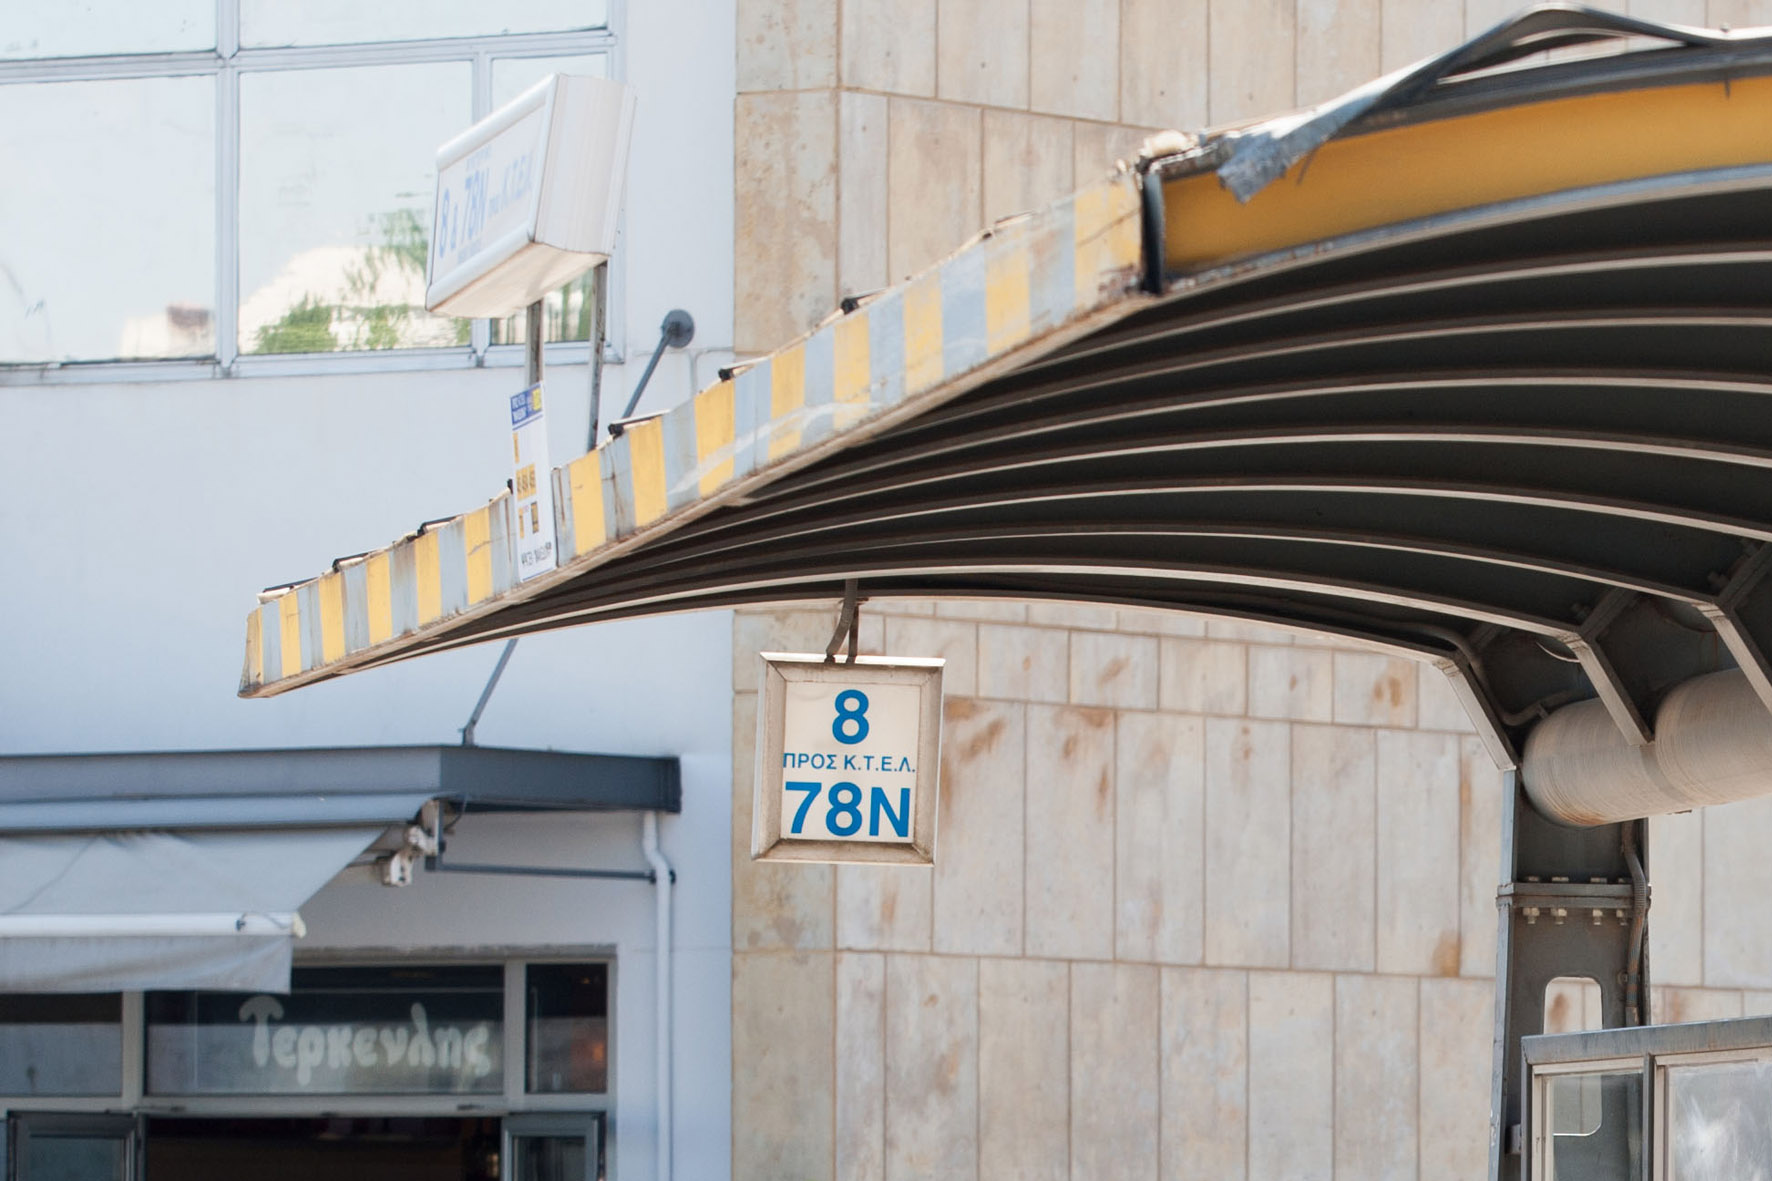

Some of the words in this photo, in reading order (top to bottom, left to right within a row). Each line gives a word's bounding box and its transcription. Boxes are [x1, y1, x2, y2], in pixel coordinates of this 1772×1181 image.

[832, 689, 869, 745] 8
[783, 752, 837, 770] ΠΡΟΣ
[844, 754, 916, 773] Κ.Τ.Ε.Λ.
[785, 781, 911, 838] 78N
